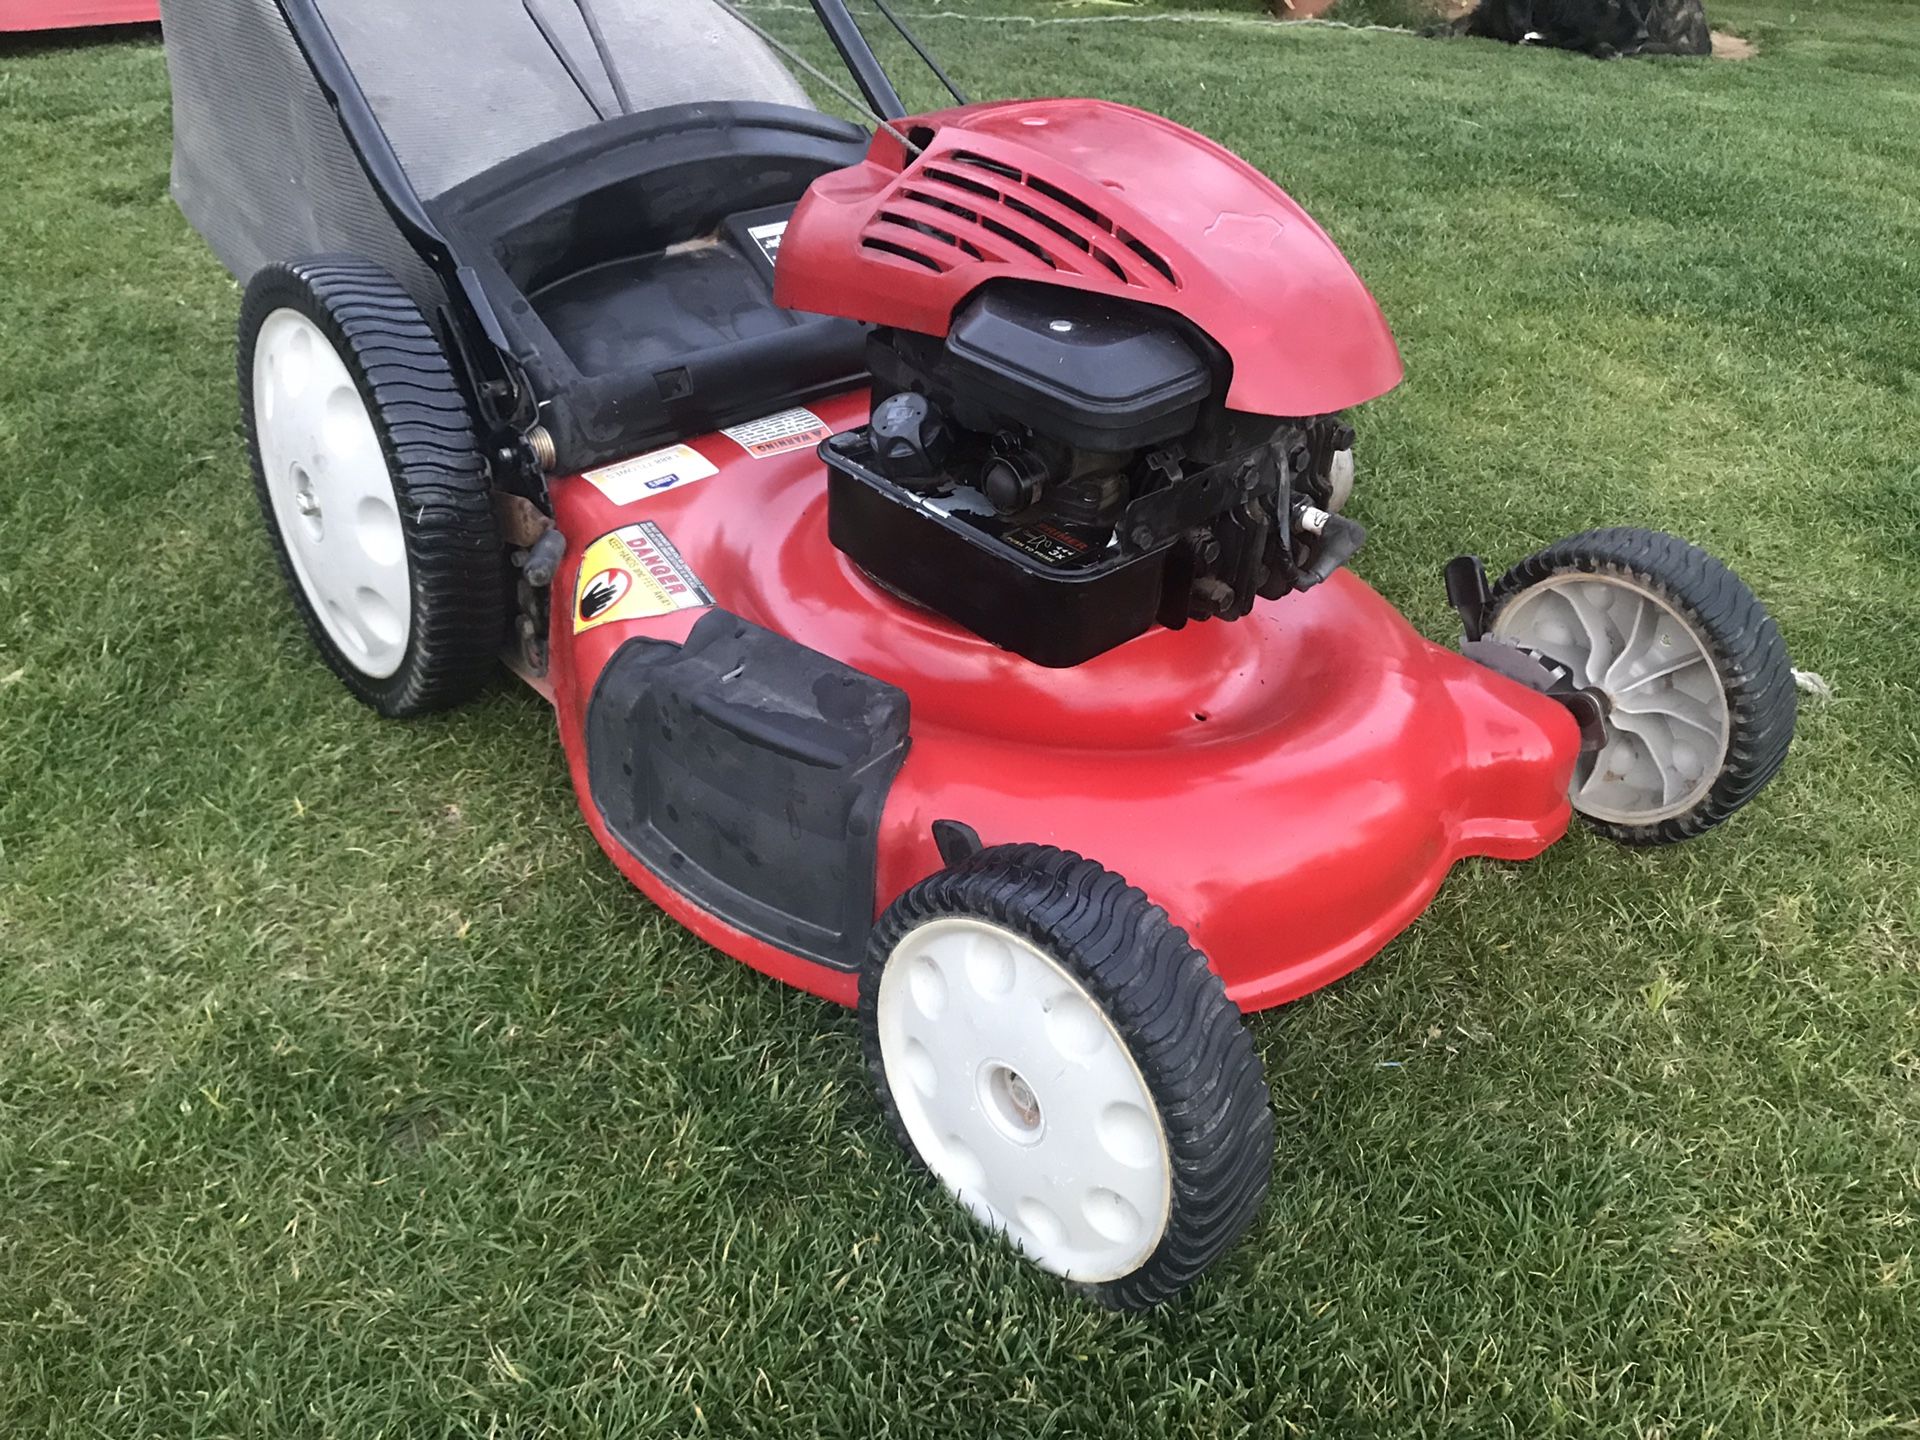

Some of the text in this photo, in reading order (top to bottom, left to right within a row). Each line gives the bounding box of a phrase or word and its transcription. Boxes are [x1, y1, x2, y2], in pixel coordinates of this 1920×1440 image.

[757, 434, 812, 452] WARNING
[608, 537, 623, 552] KEEP
[619, 550, 638, 569] HANDS
[642, 576, 660, 592] FEET
[654, 590, 672, 606] AWAY
[626, 537, 688, 595] DANGER
